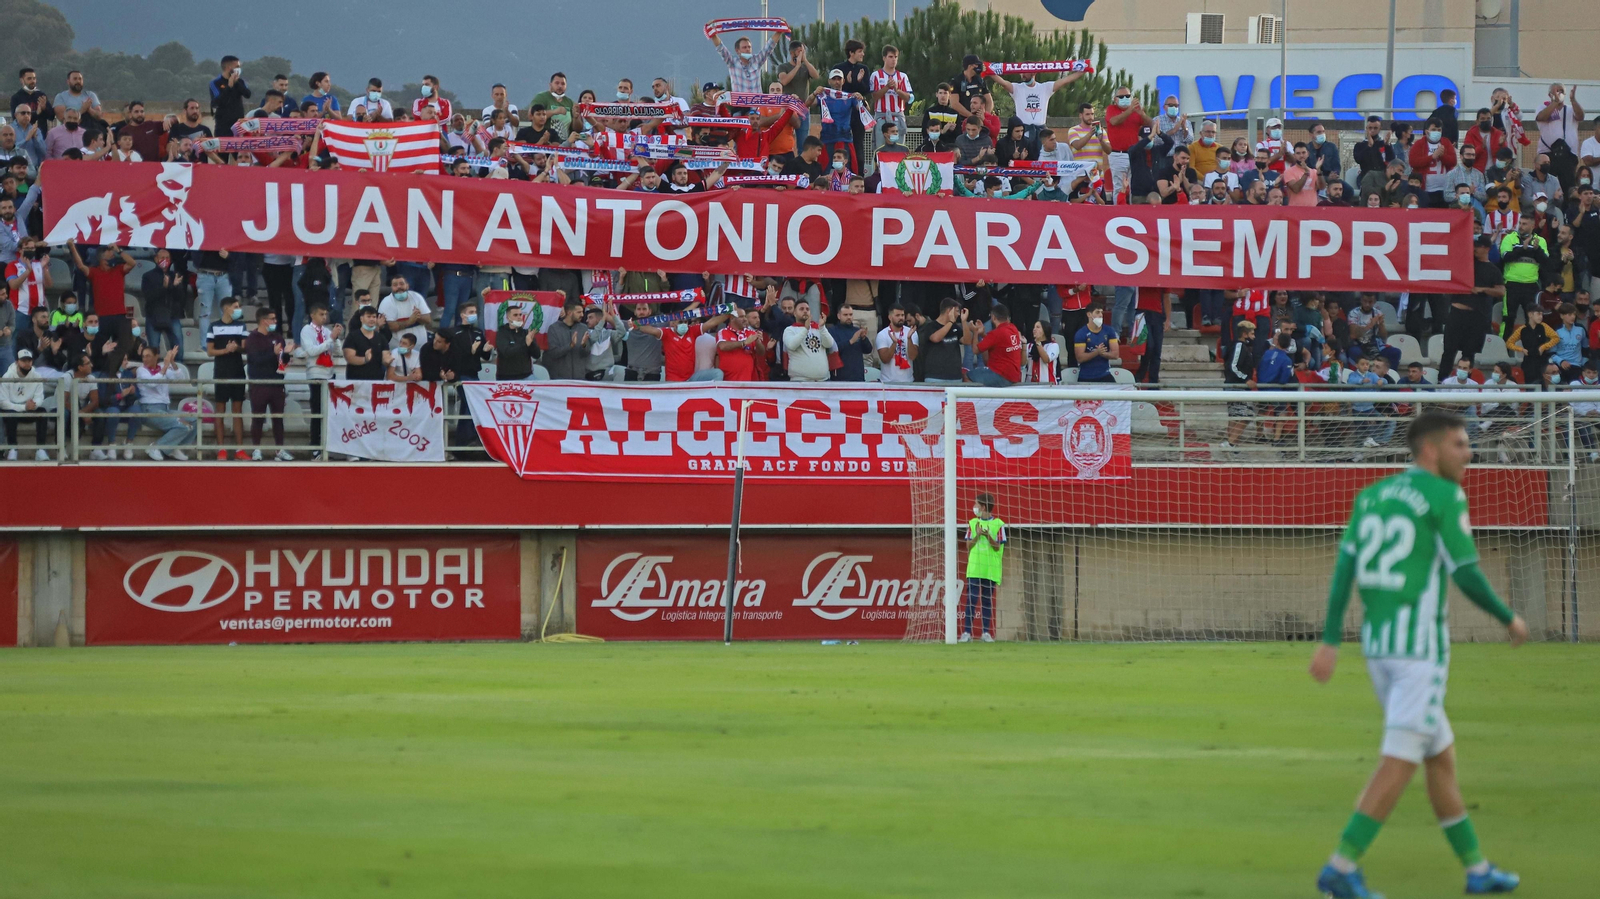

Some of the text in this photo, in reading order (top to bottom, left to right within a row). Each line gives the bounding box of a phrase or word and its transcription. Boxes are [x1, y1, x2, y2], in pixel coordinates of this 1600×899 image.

[1006, 62, 1070, 71] ALGECIRAS
[1156, 72, 1460, 121] IVECO
[726, 174, 797, 183] ALGECIRAS
[241, 182, 1452, 281] JUAN ANTONIO PARA SIEMPRE
[388, 420, 430, 452] 2003
[560, 397, 1040, 459] ALGECIRAS
[688, 459, 919, 473] GRADA ACF FONDO SUR
[1357, 513, 1416, 590] 22
[245, 547, 483, 587] HYUNDAI
[244, 588, 485, 611] PERMOTOR
[219, 615, 392, 633] ventas@permotor.com
[661, 610, 697, 622] Logística
[698, 610, 727, 622] Integra
[743, 610, 783, 622] transporte
